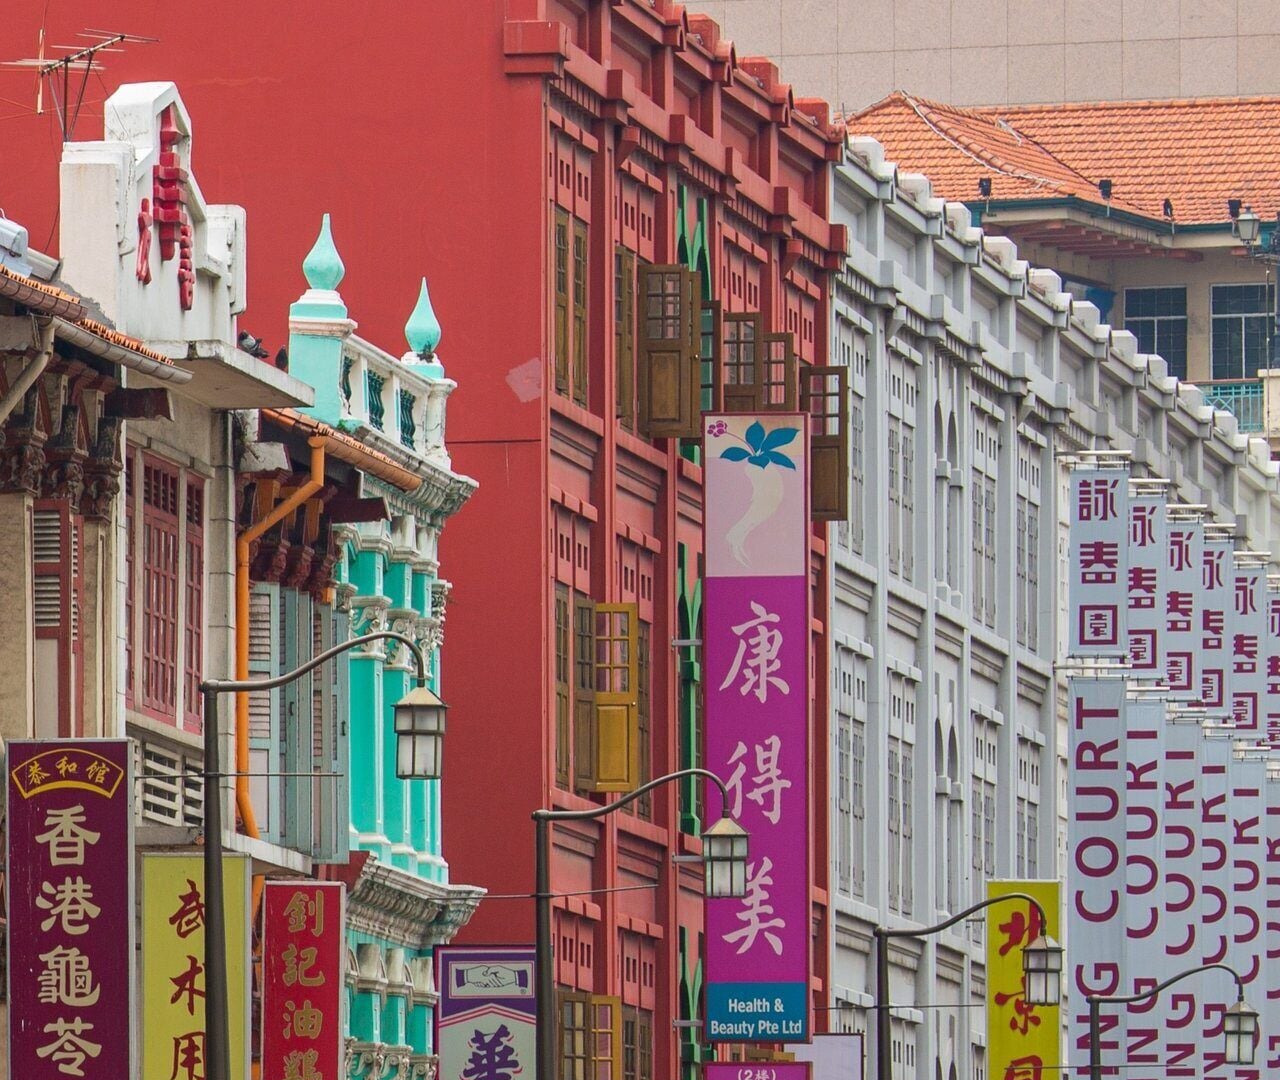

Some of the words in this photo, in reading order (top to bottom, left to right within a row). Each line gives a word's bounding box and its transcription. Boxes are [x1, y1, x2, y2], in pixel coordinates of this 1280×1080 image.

[719, 601, 791, 957] 康得美
[1075, 697, 1119, 922] COURT
[711, 1021, 754, 1037] Beauty
[758, 1021, 779, 1034] Pte
[782, 1020, 802, 1034] Ltd
[728, 998, 770, 1013] Health
[774, 998, 784, 1013] &
